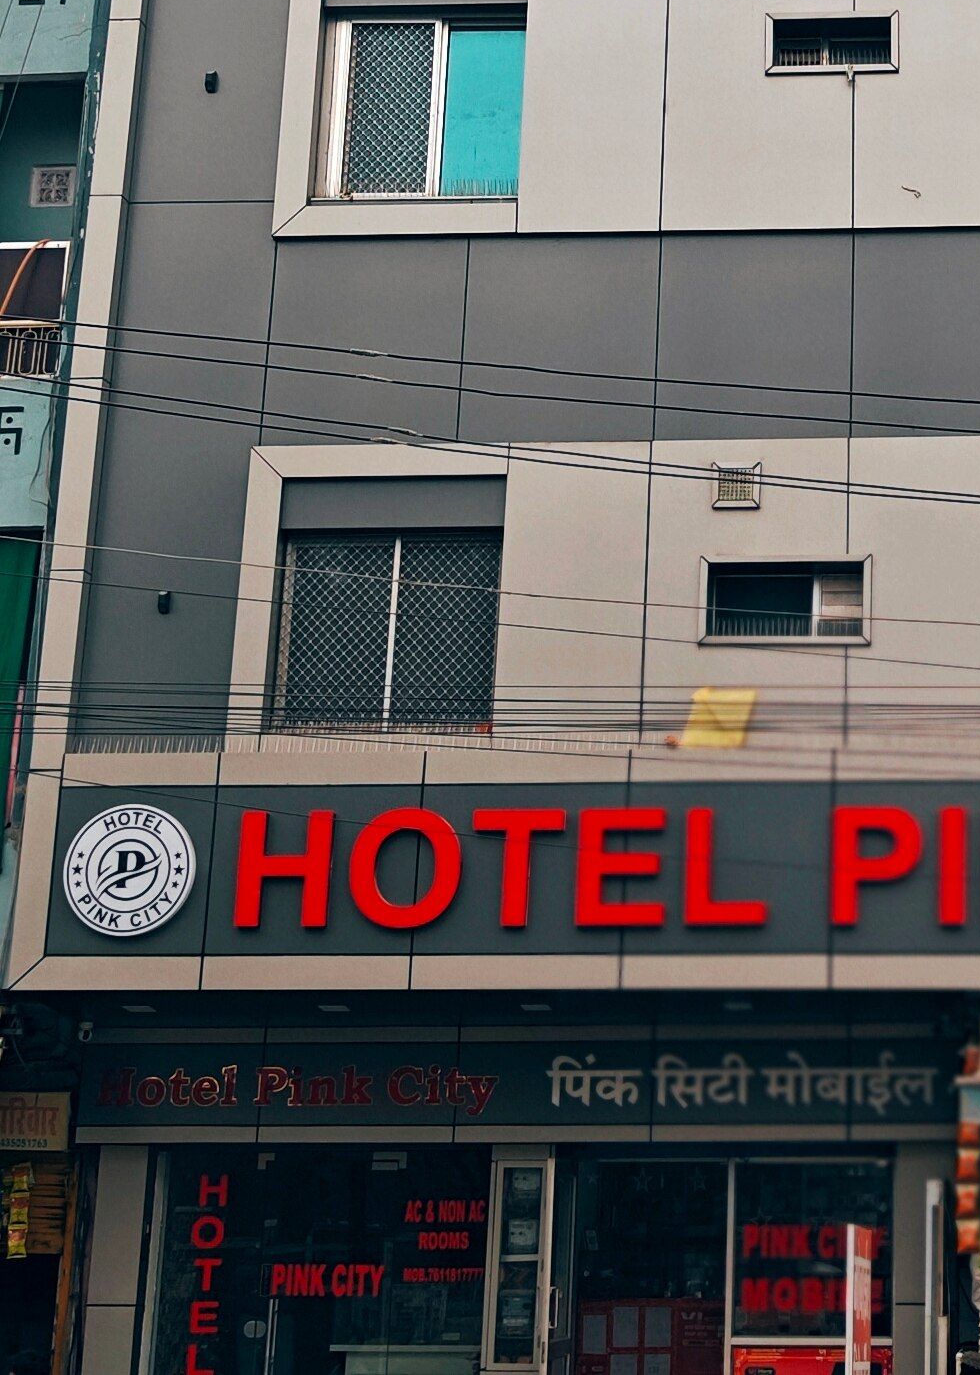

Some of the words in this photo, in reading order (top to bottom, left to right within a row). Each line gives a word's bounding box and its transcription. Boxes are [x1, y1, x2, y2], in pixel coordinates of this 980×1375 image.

[103, 811, 164, 835] HOTEL
[233, 808, 768, 929] HOTEL
[77, 893, 122, 928] PINK
[130, 891, 173, 927] CITY
[97, 1064, 239, 1108] Hotel
[253, 1065, 373, 1108] Pink
[387, 1065, 499, 1116] City
[546, 1053, 643, 1108] पिंक
[651, 1054, 755, 1109] सिटी
[761, 1050, 938, 1116] मोबाईल
[405, 1200, 422, 1223] AC
[425, 1200, 435, 1223] &
[439, 1200, 465, 1222] NON
[468, 1200, 486, 1222] AC
[418, 1231, 469, 1250] ROOMS
[742, 1223, 812, 1260] PINK
[817, 1224, 888, 1260] CIY
[186, 1174, 230, 1375] HOTEL
[271, 1263, 326, 1297] PINK
[331, 1263, 385, 1297] CITY
